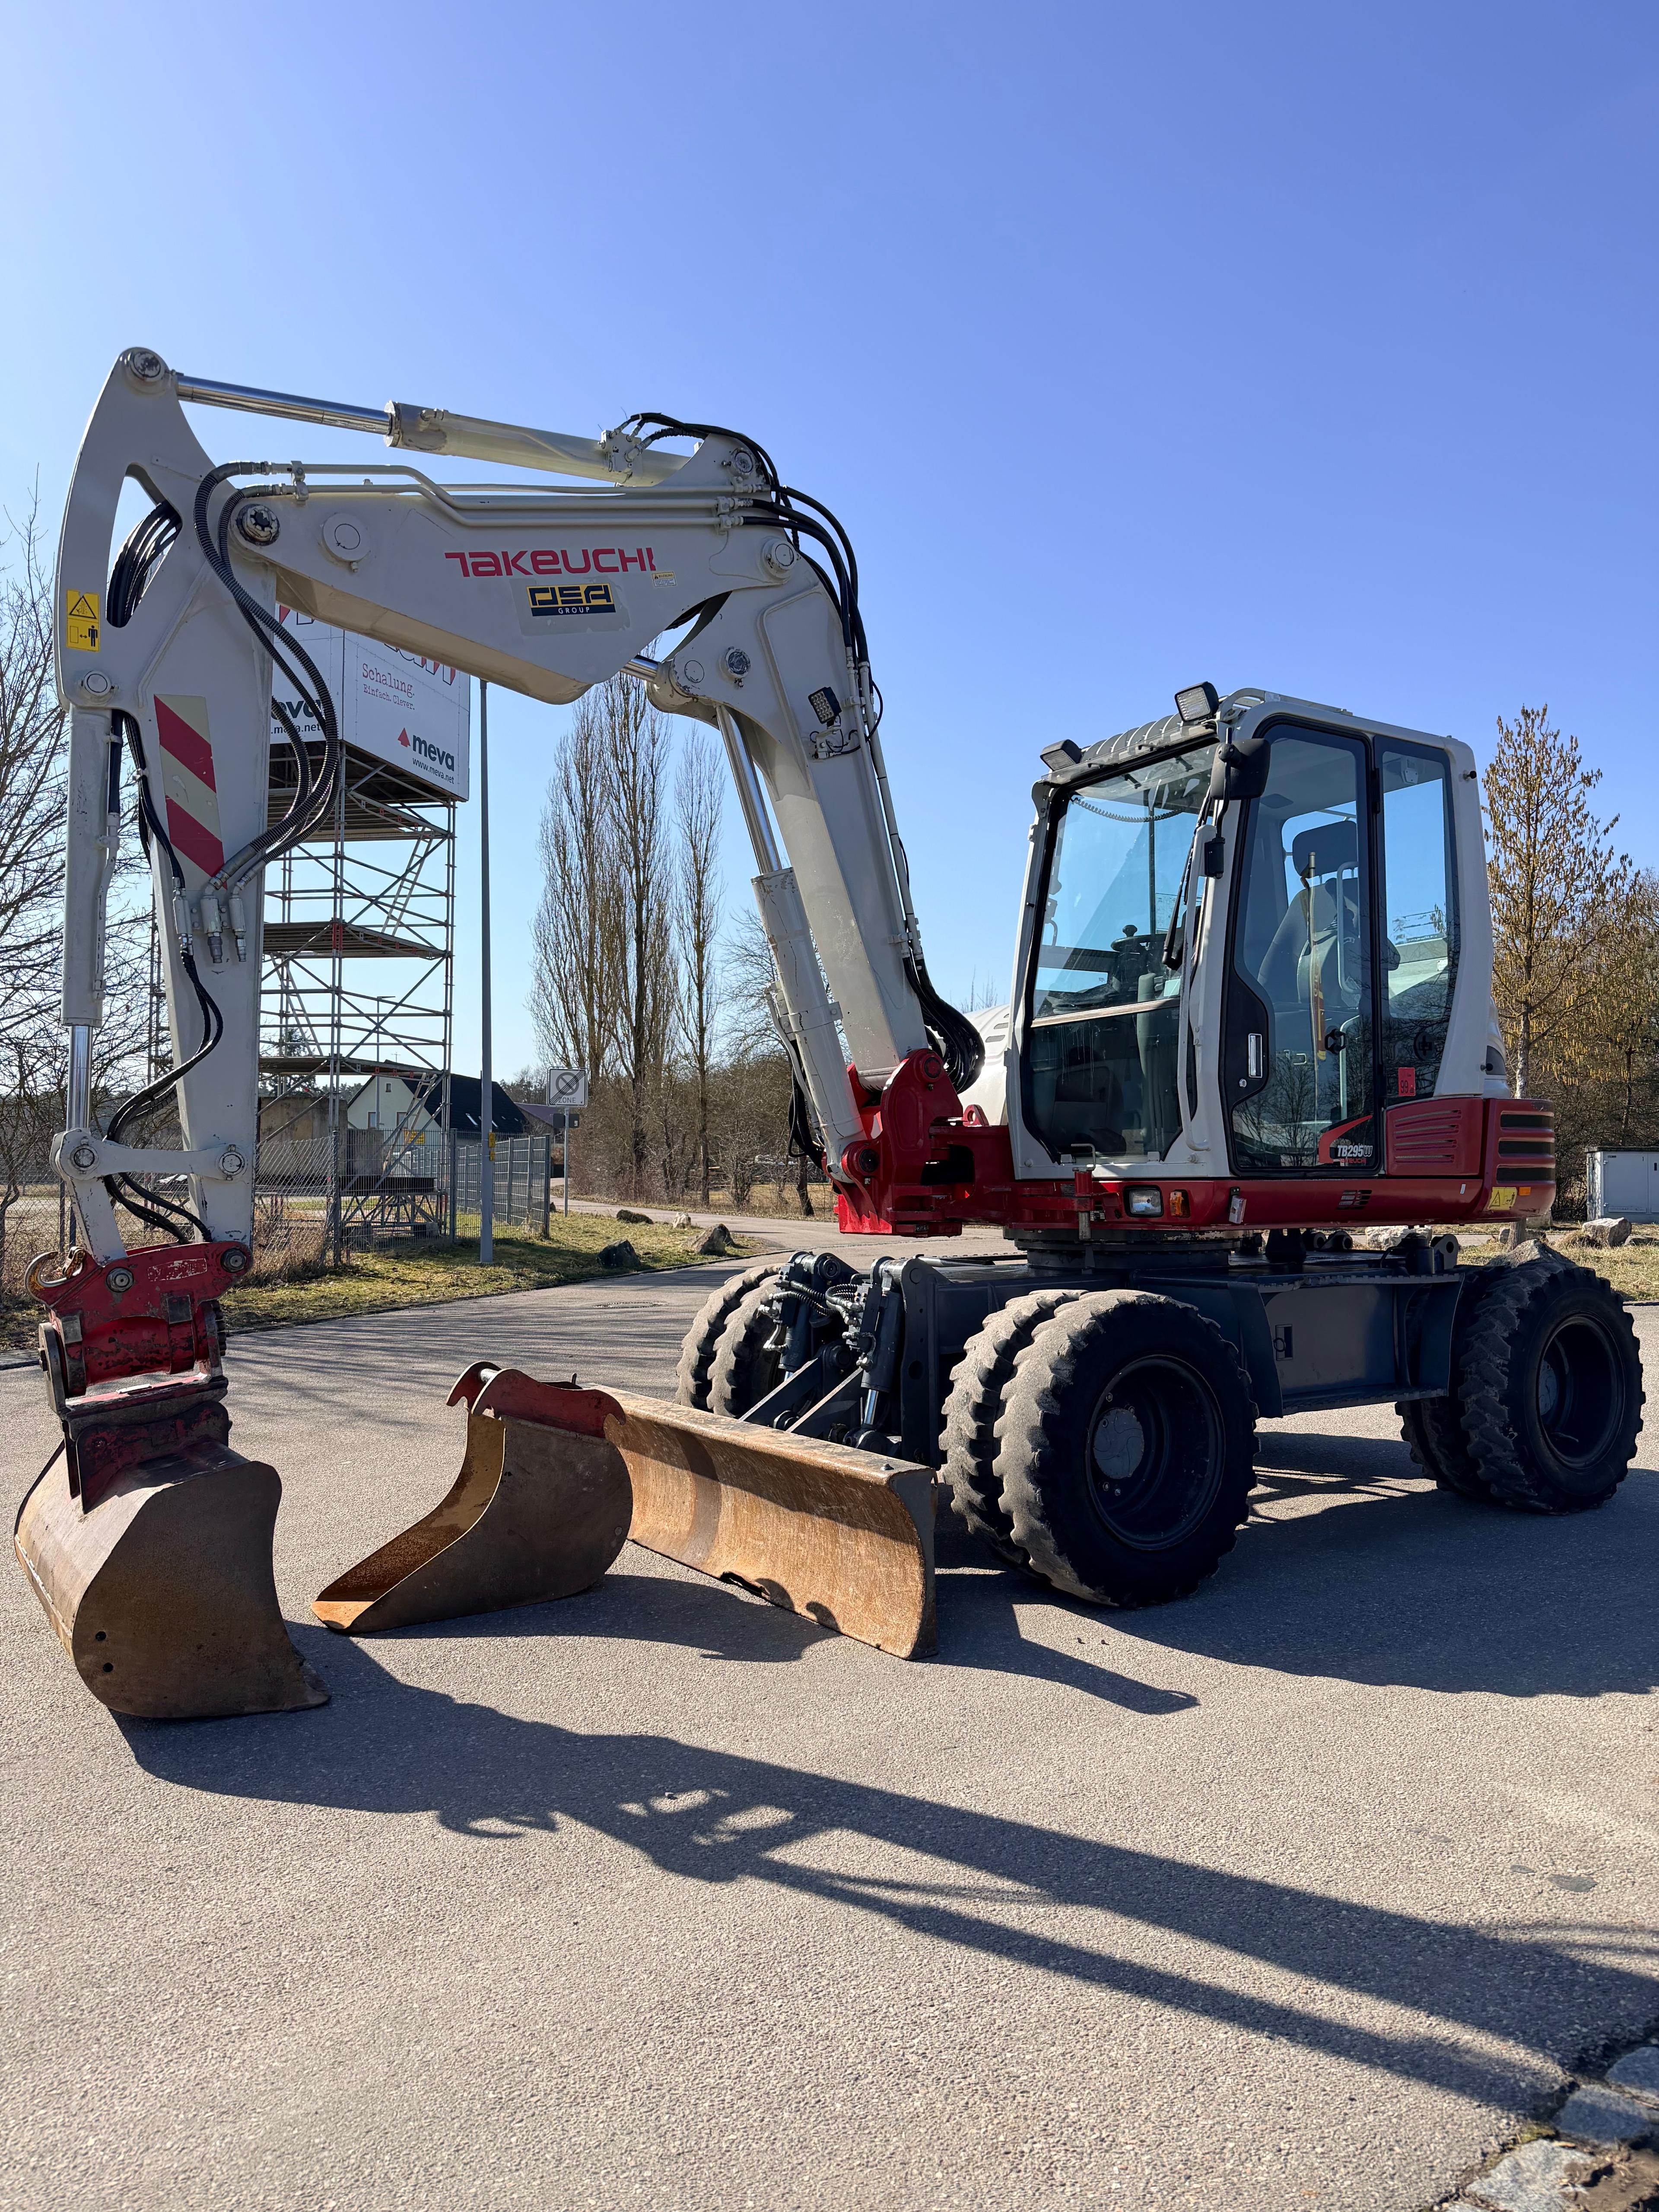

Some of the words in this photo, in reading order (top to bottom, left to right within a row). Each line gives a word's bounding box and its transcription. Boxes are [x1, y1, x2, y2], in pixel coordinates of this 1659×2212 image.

[362, 663, 415, 698] Schalung.
[363, 683, 391, 702] Einfach.
[393, 695, 415, 710] Clever.
[413, 734, 454, 772] meva
[413, 757, 454, 784] www.meva.net
[1337, 1145, 1373, 1157] TB295W
